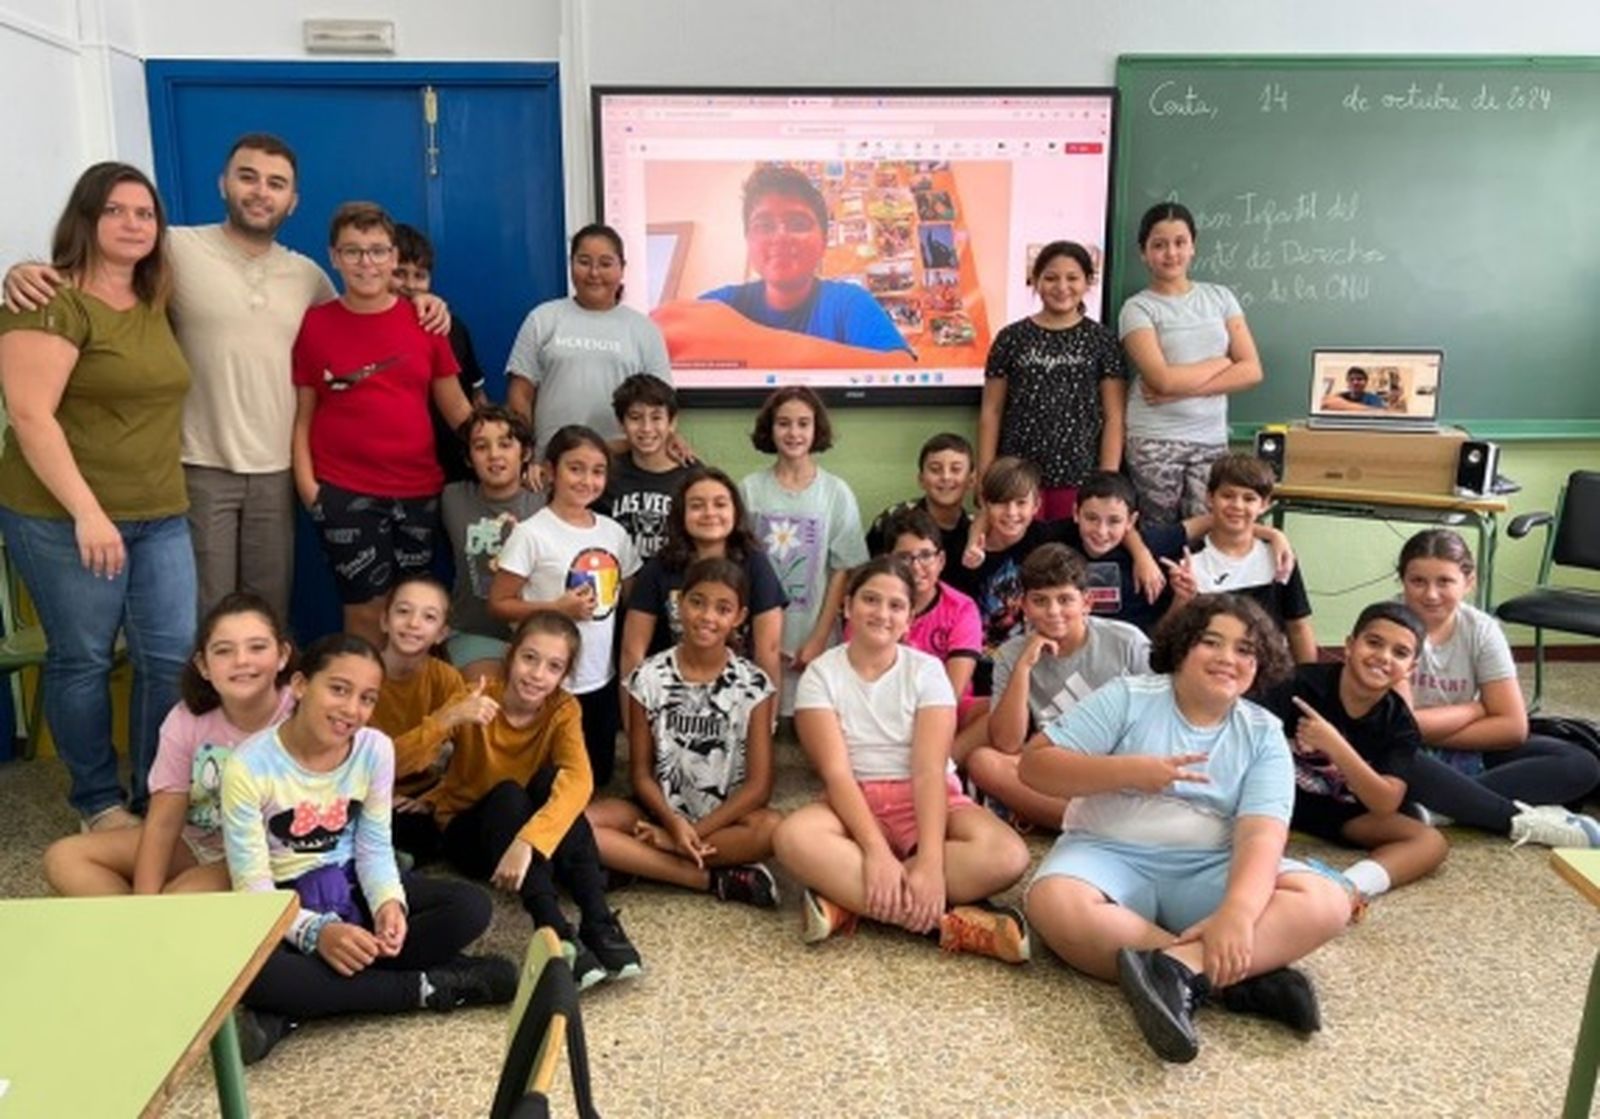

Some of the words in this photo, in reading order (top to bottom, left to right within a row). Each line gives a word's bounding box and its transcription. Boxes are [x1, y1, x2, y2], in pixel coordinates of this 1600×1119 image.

[1258, 82, 1288, 112] 14
[1341, 82, 1371, 112] de
[1380, 81, 1462, 111] octubre
[1470, 83, 1500, 111] de
[612, 492, 640, 517] LAS
